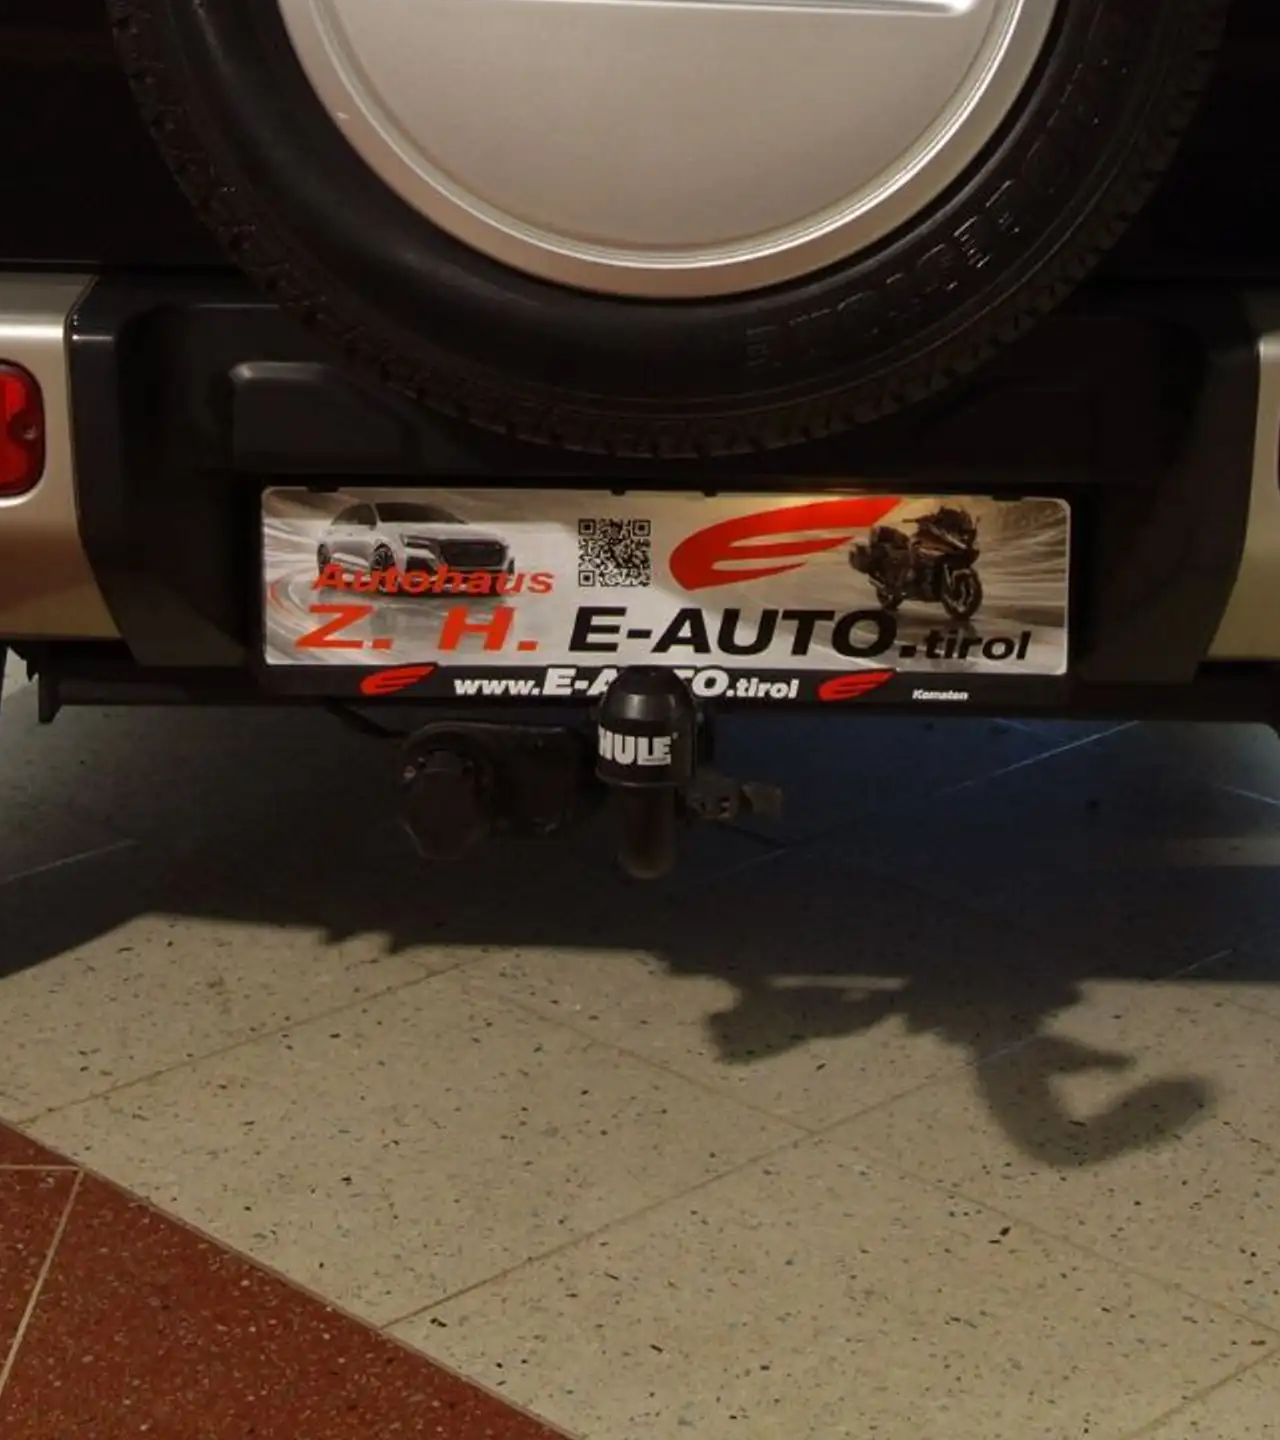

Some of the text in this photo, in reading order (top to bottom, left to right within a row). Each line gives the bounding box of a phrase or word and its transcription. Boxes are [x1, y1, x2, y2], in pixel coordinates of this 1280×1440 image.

[312, 562, 556, 595] Autohaus
[293, 604, 1033, 661] Z. H. E-AUTO.tirol
[452, 666, 801, 700] www.E-AO.tirol
[597, 723, 673, 766] HULE
